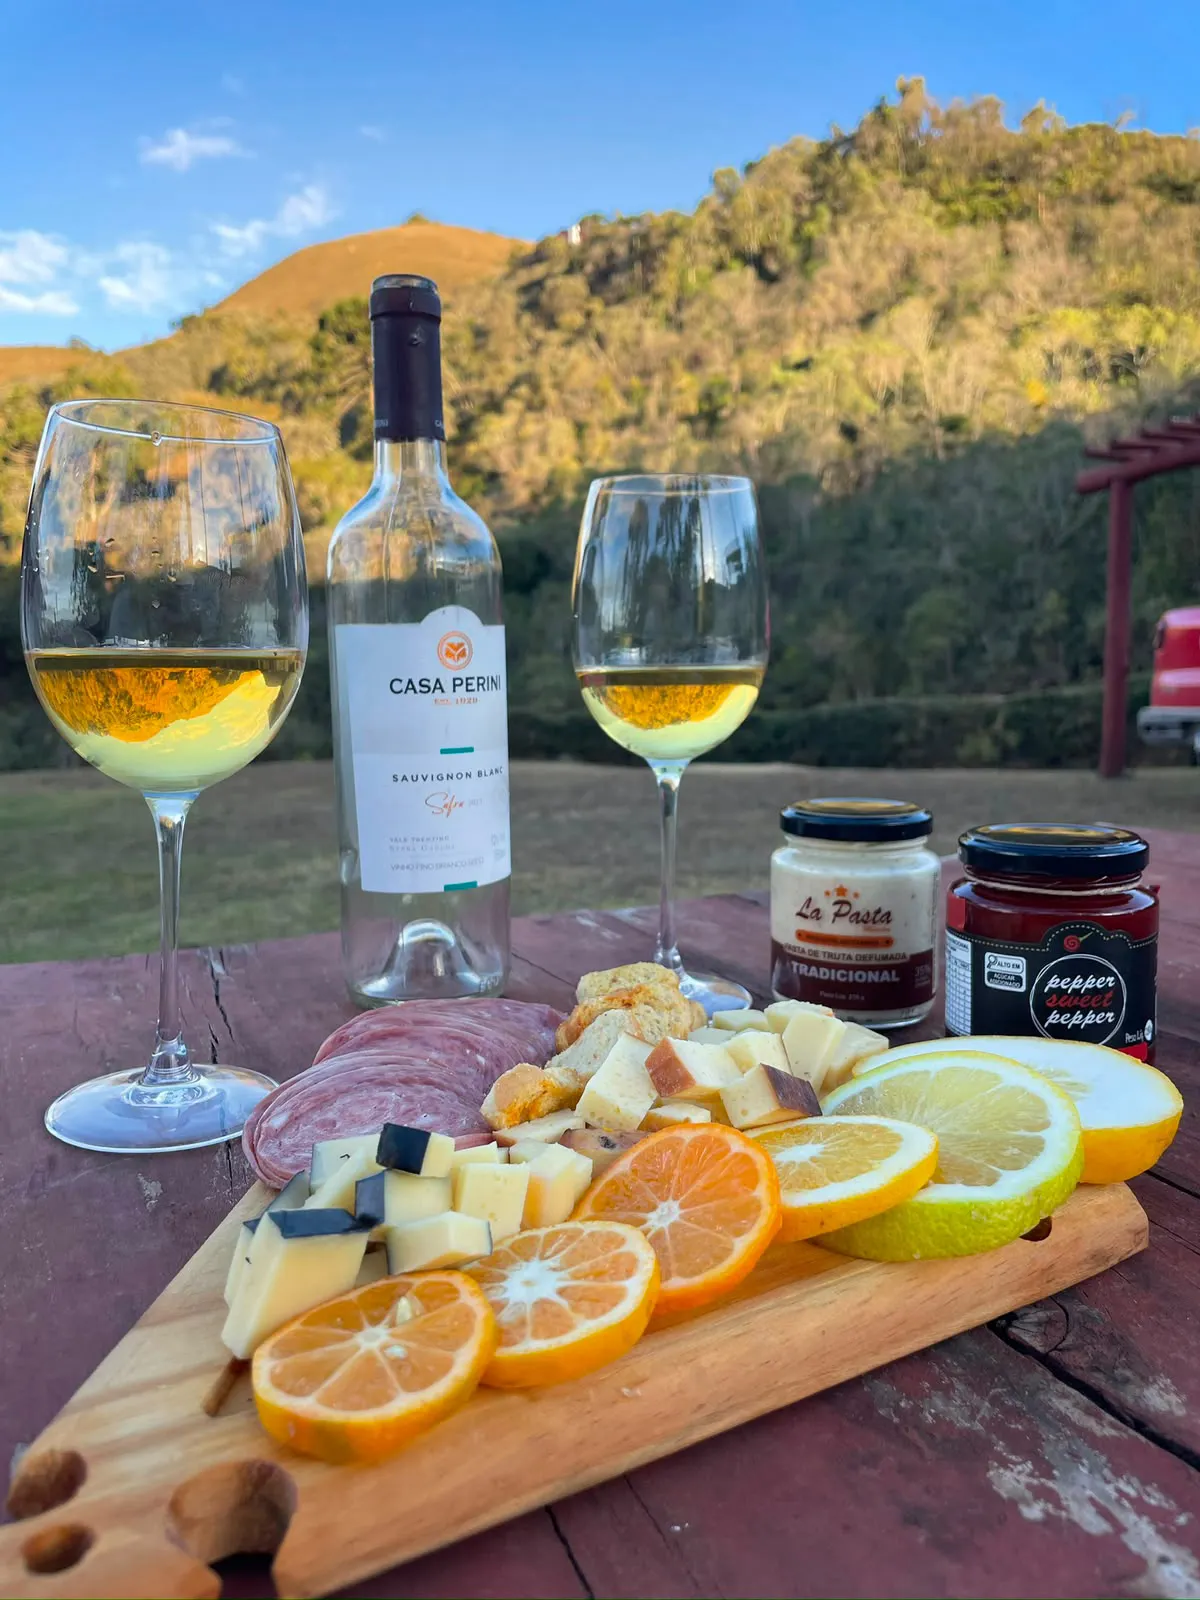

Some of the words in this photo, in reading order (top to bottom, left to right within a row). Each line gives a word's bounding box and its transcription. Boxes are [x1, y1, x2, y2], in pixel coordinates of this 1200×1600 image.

[389, 677, 445, 695] CASA
[452, 675, 501, 693] PERINI
[392, 771, 472, 783] SAUVIGNON
[477, 765, 503, 779] BLANC
[795, 896, 823, 921] La
[831, 899, 893, 924] Pasta
[808, 948, 820, 958] DE
[823, 951, 852, 962] TRUTA
[855, 952, 907, 962] DEFUMADA
[997, 960, 1011, 970] ALTO
[1011, 962, 1021, 970] EM
[791, 960, 900, 983] TRADICIONAL
[1043, 974, 1116, 994] pepper
[1045, 990, 1114, 1008] sweet
[1043, 1009, 1116, 1029] pepper
